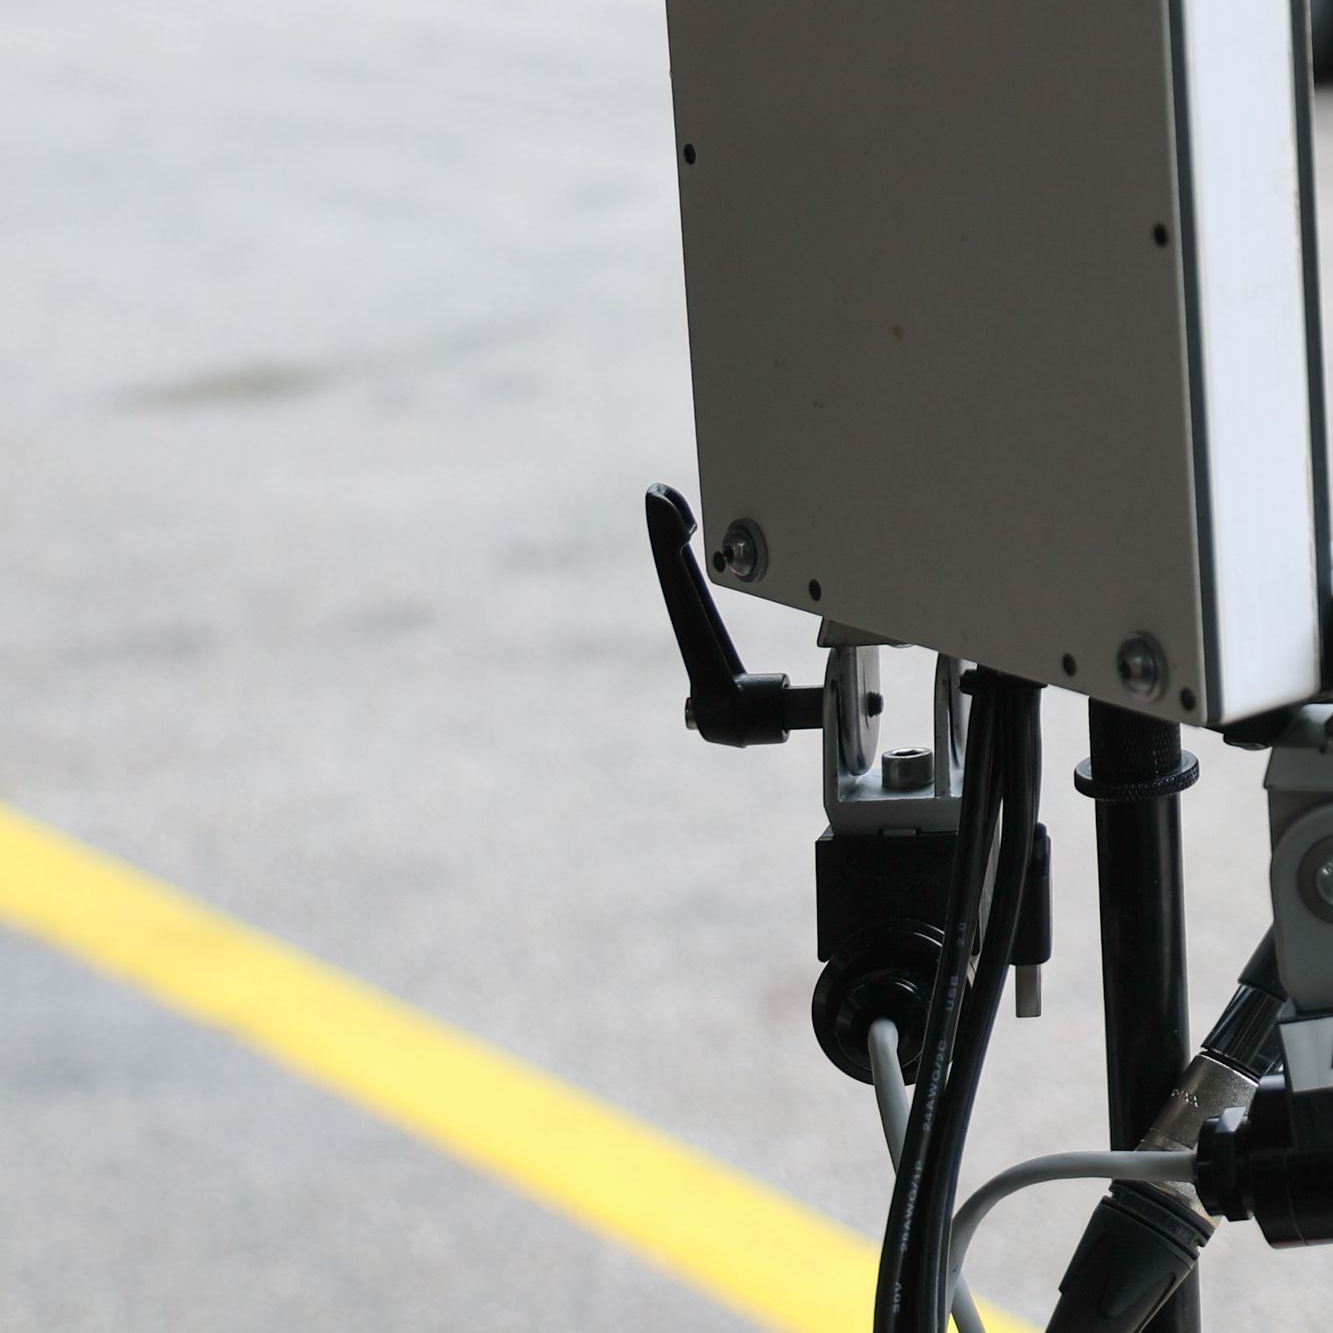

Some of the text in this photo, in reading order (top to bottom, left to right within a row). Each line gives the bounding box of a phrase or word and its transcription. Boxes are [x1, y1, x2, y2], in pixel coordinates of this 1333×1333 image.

[891, 1281, 903, 1315] 30V
[922, 1039, 947, 1132] 24AWG/2C
[944, 975, 959, 1012] USB
[956, 922, 968, 947] 2.0
